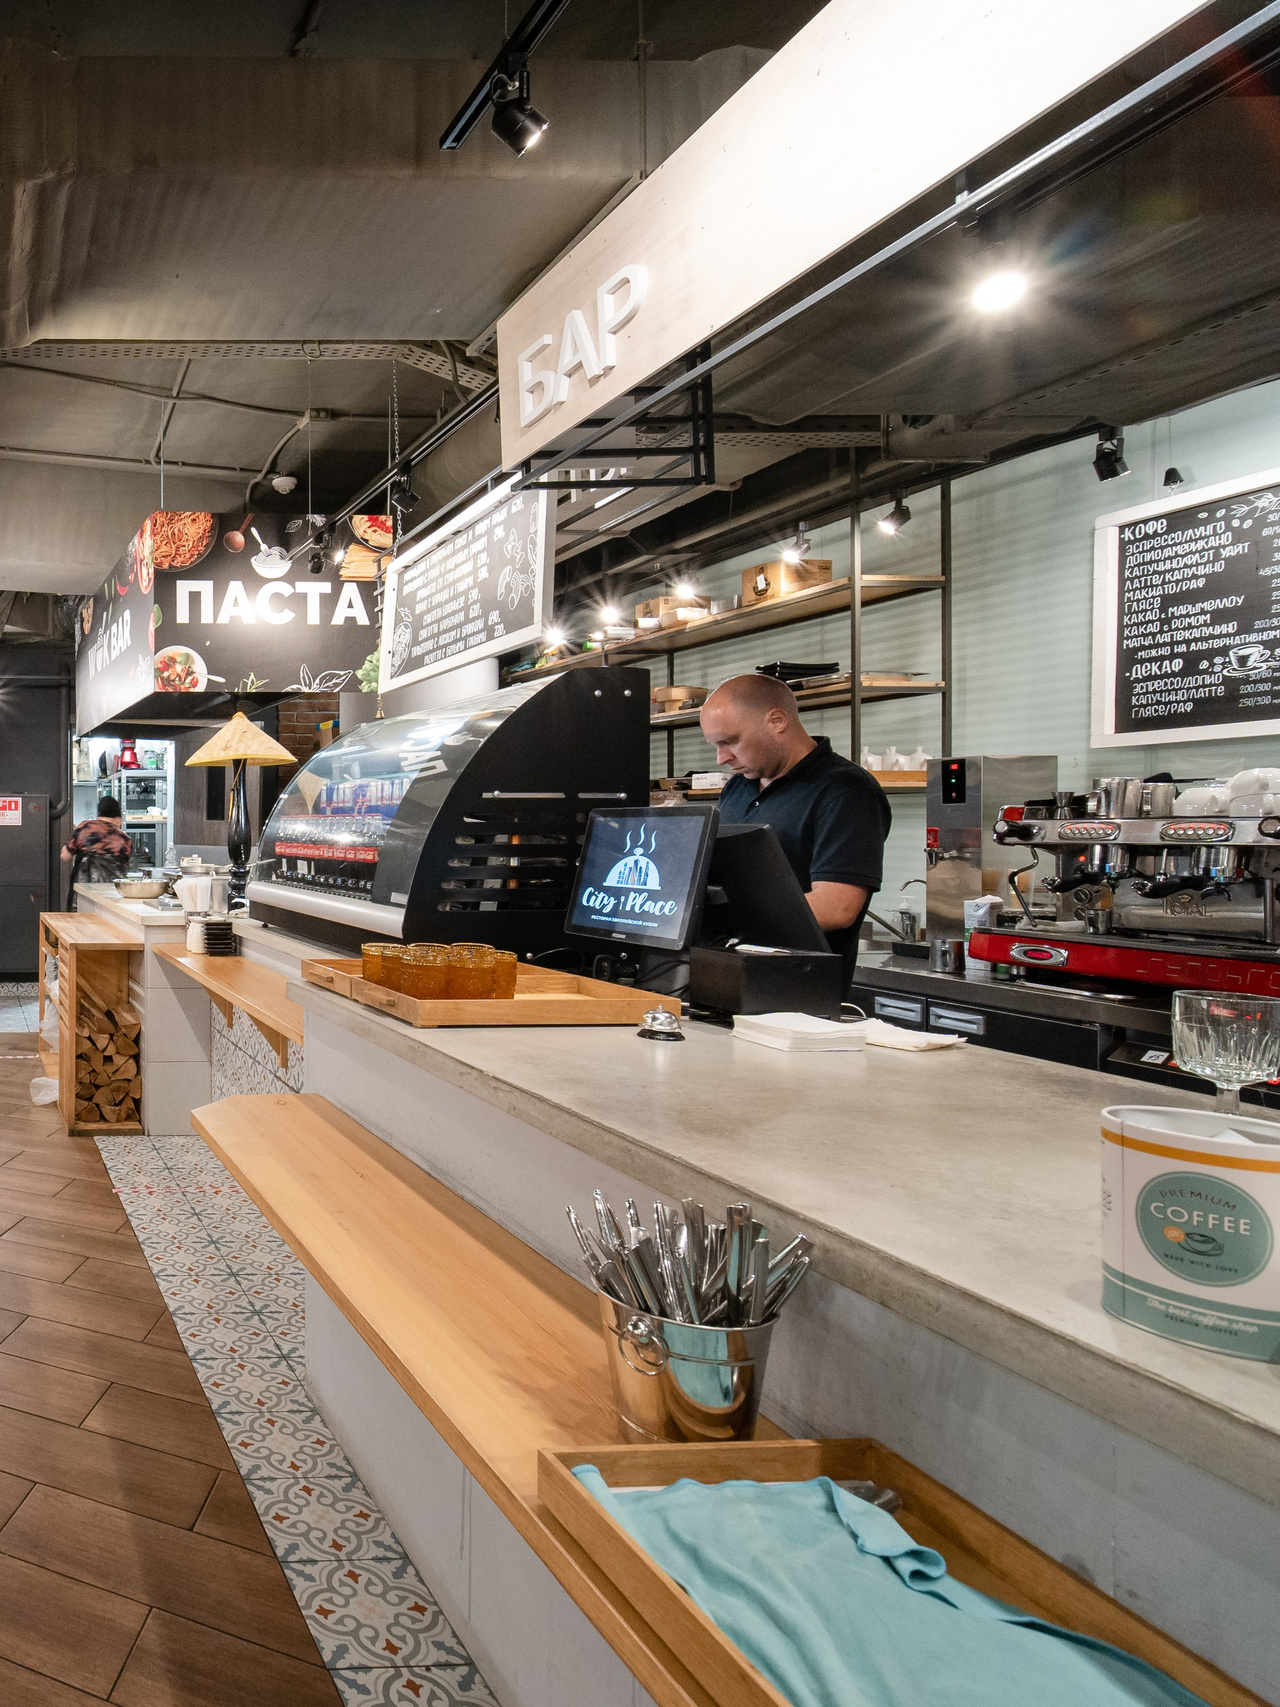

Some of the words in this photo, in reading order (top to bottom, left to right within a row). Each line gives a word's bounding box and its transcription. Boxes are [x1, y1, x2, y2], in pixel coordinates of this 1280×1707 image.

[518, 264, 649, 428] БАР
[1124, 549, 1215, 579] КАПУЧИНО/ФЛЭТ
[1220, 542, 1251, 559] УАЙТ
[1165, 560, 1225, 583] КАПУЧИНО
[1124, 577, 1206, 602] МАКИАТО/РАФ
[176, 580, 370, 625] ПАСТА
[1123, 608, 1160, 626] КАКАО
[1168, 595, 1245, 618] МАРШМЕЛЛОУ
[1124, 597, 1161, 614] ГЛЯСЕ
[110, 608, 132, 662] BAR
[1123, 621, 1160, 638] КАКАО
[1171, 613, 1211, 629] РОМОМ
[1123, 636, 1154, 649] МАТЧА
[1137, 646, 1171, 660] МОЖНО
[1174, 644, 1187, 654] НА
[1189, 630, 1280, 651] АЛЬТЕРНАТИВНОМ
[1130, 658, 1184, 680] ДЕКАФ
[1131, 685, 1225, 706] КАПУЧИНО/ЛАТТЕ
[1239, 682, 1272, 694] 200/300
[1132, 672, 1223, 694] ЭСПРЕССО/ДОПИО
[1131, 702, 1194, 719] ГЛЯСЕ/РАФ
[1238, 695, 1272, 707] 250/300
[581, 886, 618, 913] City
[625, 891, 677, 916] Place
[1163, 897, 1213, 917] ROYAL
[590, 914, 612, 922] РЕСТОРАН
[1160, 1189, 1237, 1211] PREMIUM
[1150, 1202, 1252, 1235] COFFEE
[1164, 1253, 1184, 1263] MADE
[1189, 1259, 1211, 1268] WITH
[1216, 1265, 1239, 1274] LOVE
[1165, 1314, 1200, 1328] PREMIUM
[1204, 1325, 1239, 1337] COFFEE
[1169, 1306, 1189, 1317] best
[1192, 1312, 1229, 1327] coffee
[1232, 1321, 1259, 1334] shop
